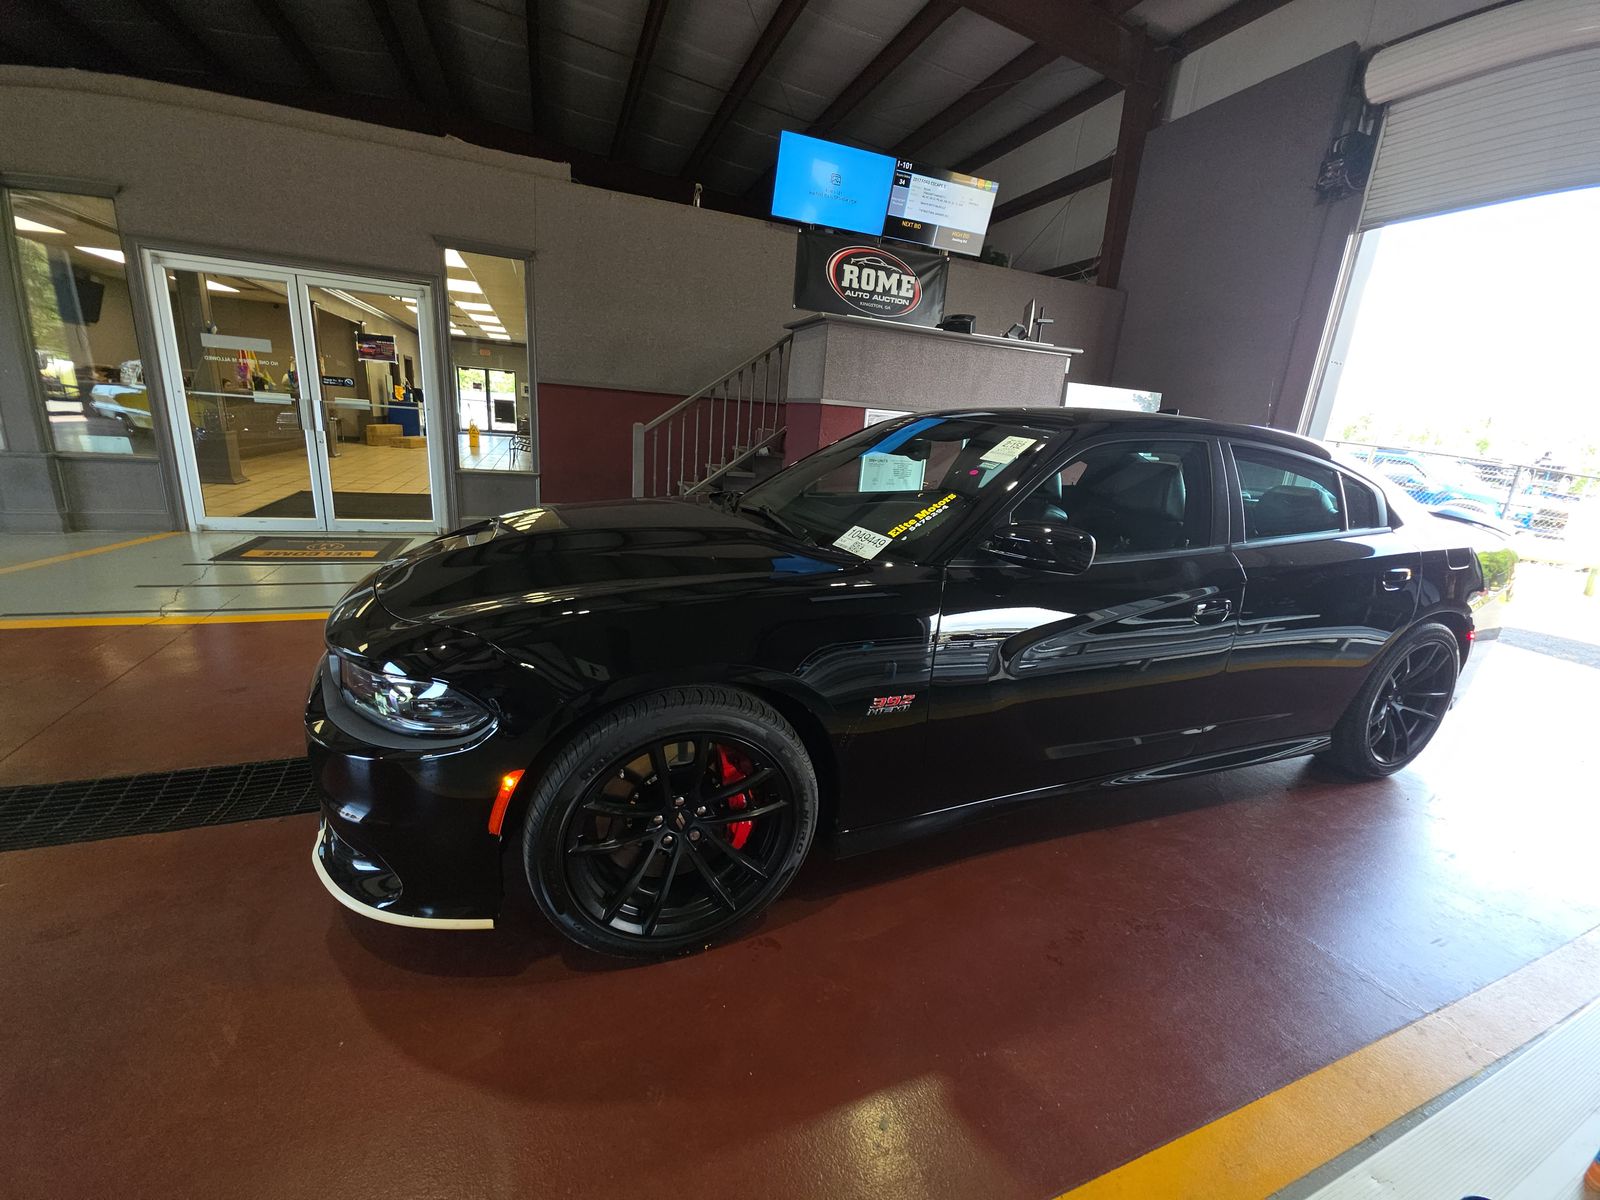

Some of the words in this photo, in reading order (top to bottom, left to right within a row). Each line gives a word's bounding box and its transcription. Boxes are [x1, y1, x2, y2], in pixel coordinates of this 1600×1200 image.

[898, 178, 906, 186] 34
[901, 220, 914, 228] NEXT
[841, 263, 916, 298] ROME
[844, 289, 870, 299] AUTO
[872, 294, 910, 306] AUCTION
[887, 517, 917, 538] Elite
[915, 493, 957, 519] Motors
[847, 528, 887, 549] 1049449
[873, 694, 916, 708] 392
